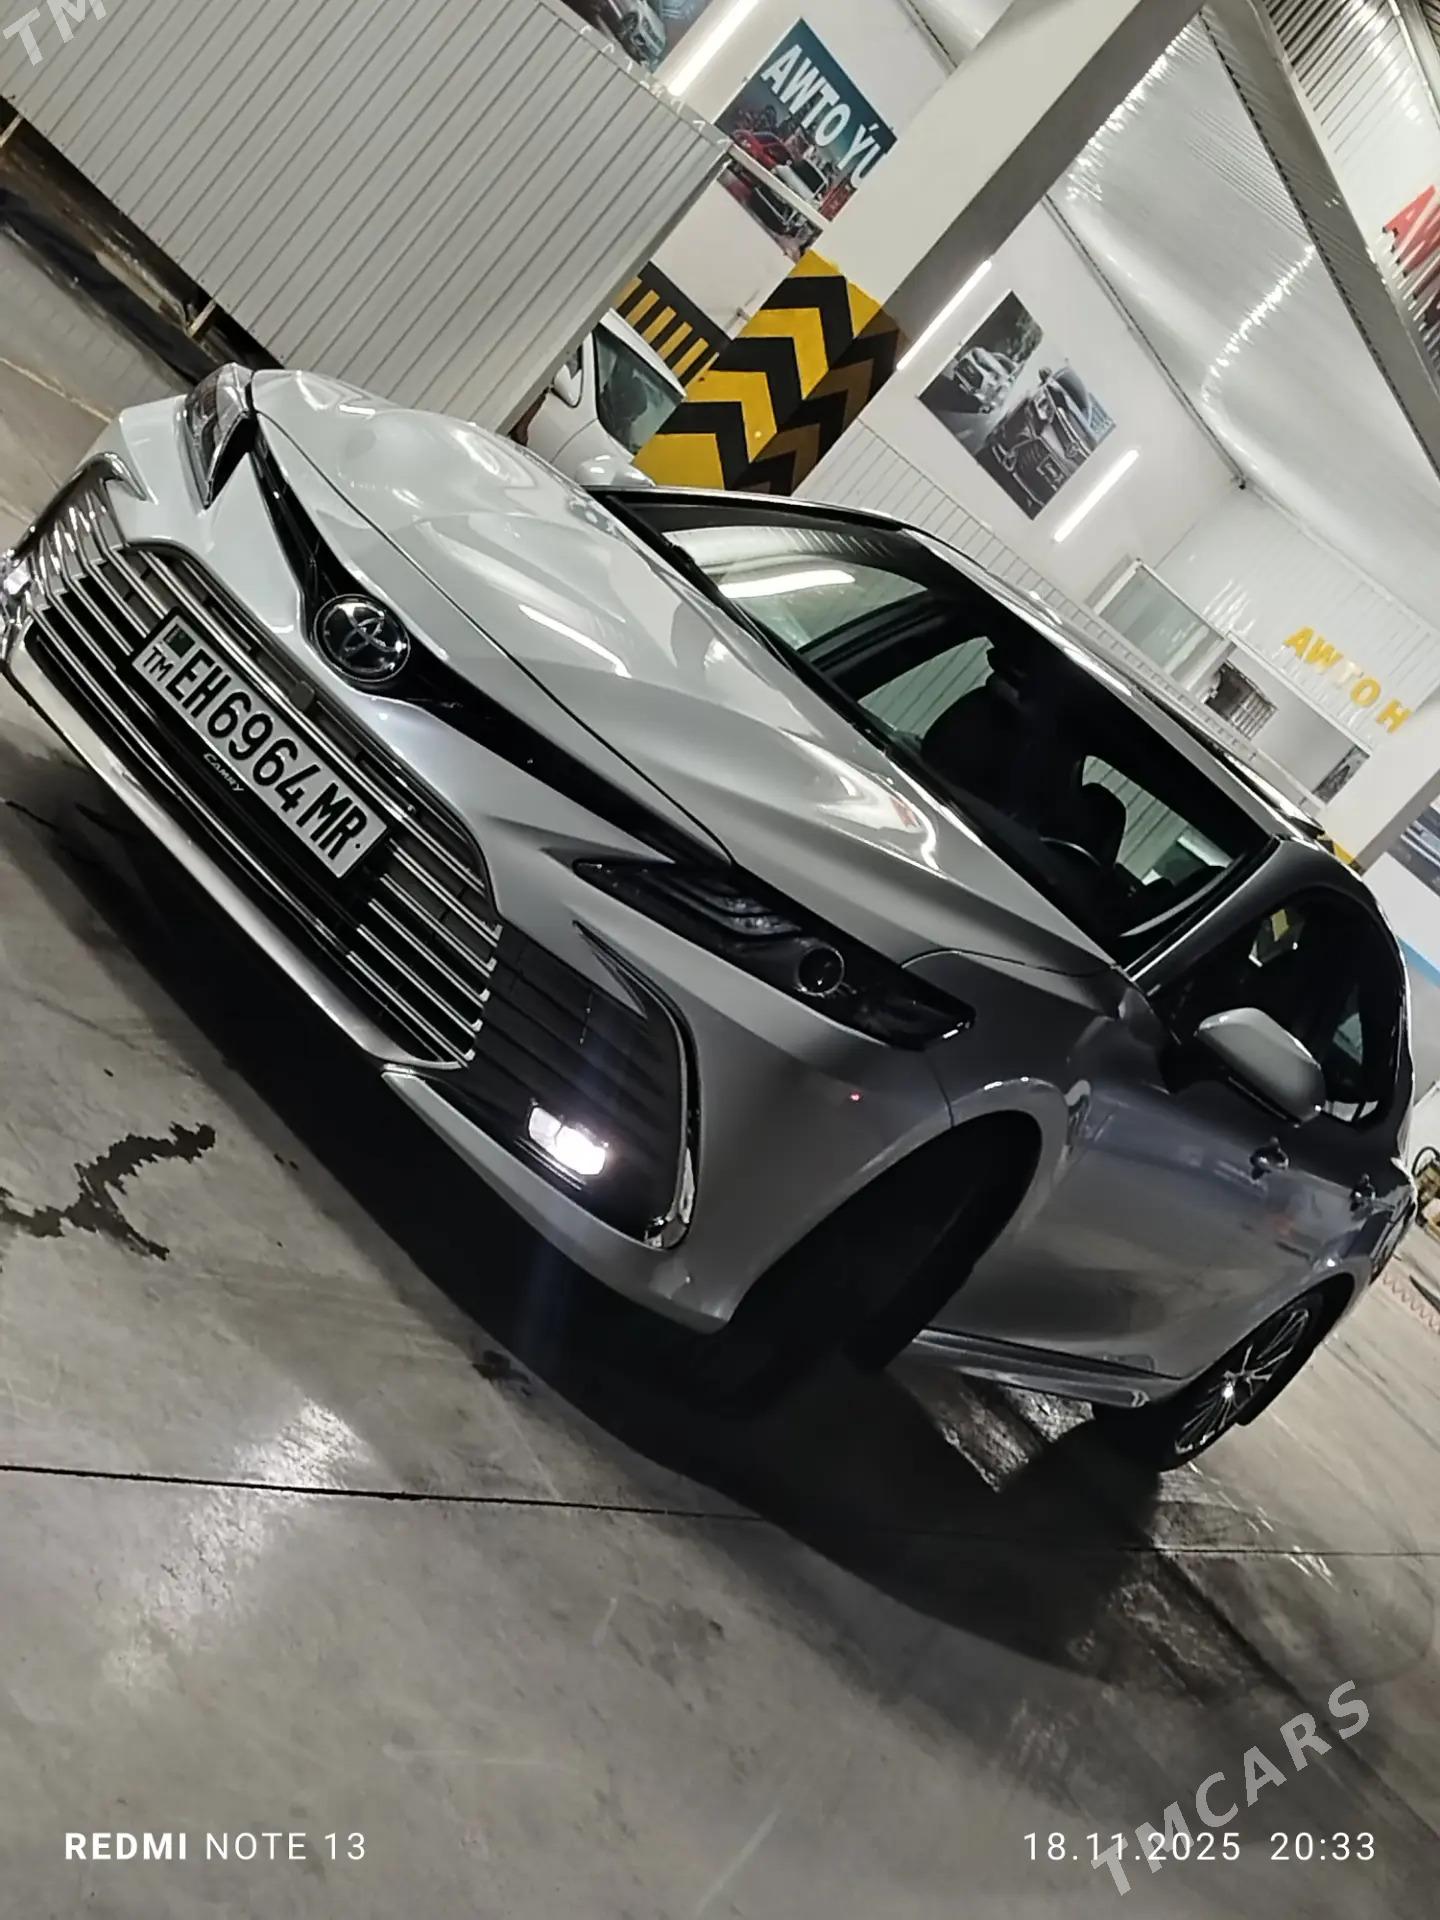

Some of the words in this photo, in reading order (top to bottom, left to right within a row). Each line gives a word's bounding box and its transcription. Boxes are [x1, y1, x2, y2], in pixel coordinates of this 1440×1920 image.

[761, 44, 851, 146] AWTO
[142, 644, 173, 682] TM
[1283, 627, 1381, 706] AWTO
